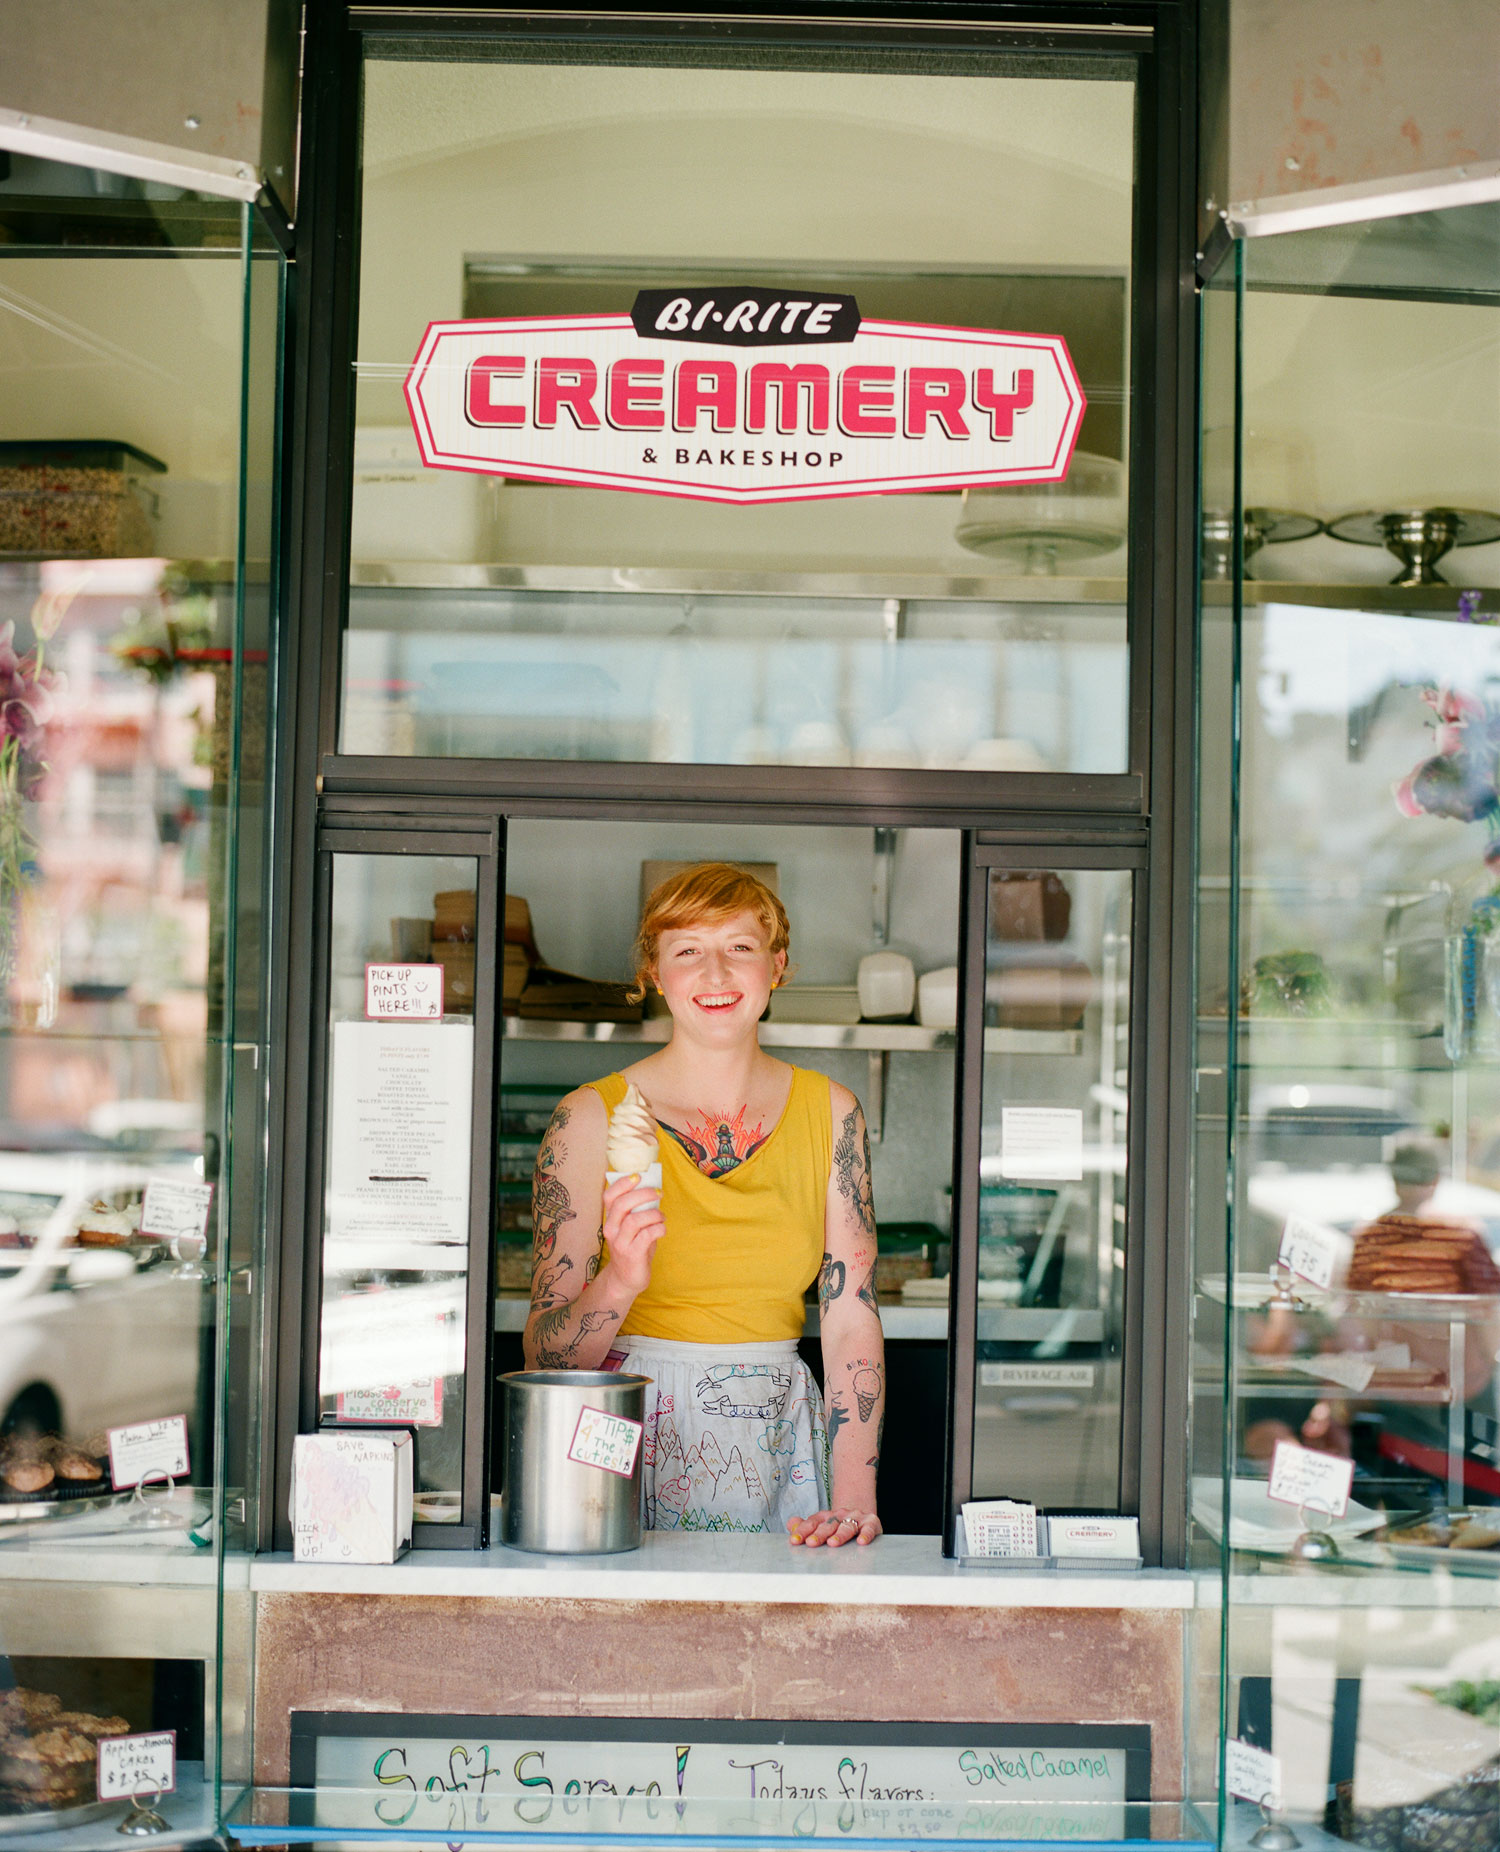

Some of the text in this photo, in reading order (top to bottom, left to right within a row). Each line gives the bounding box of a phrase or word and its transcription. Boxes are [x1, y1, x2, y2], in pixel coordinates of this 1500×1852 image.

[464, 355, 1035, 441] CREAMERY
[642, 448, 846, 468] & BAKESHOP
[371, 968, 412, 982] PICK UP
[372, 983, 407, 997] PINTS
[349, 1406, 419, 1417] NAPKINS
[370, 1399, 427, 1408] conserve
[594, 1436, 616, 1454] The
[958, 1750, 1112, 1787] Salted Caramel
[374, 1745, 500, 1830] Soft
